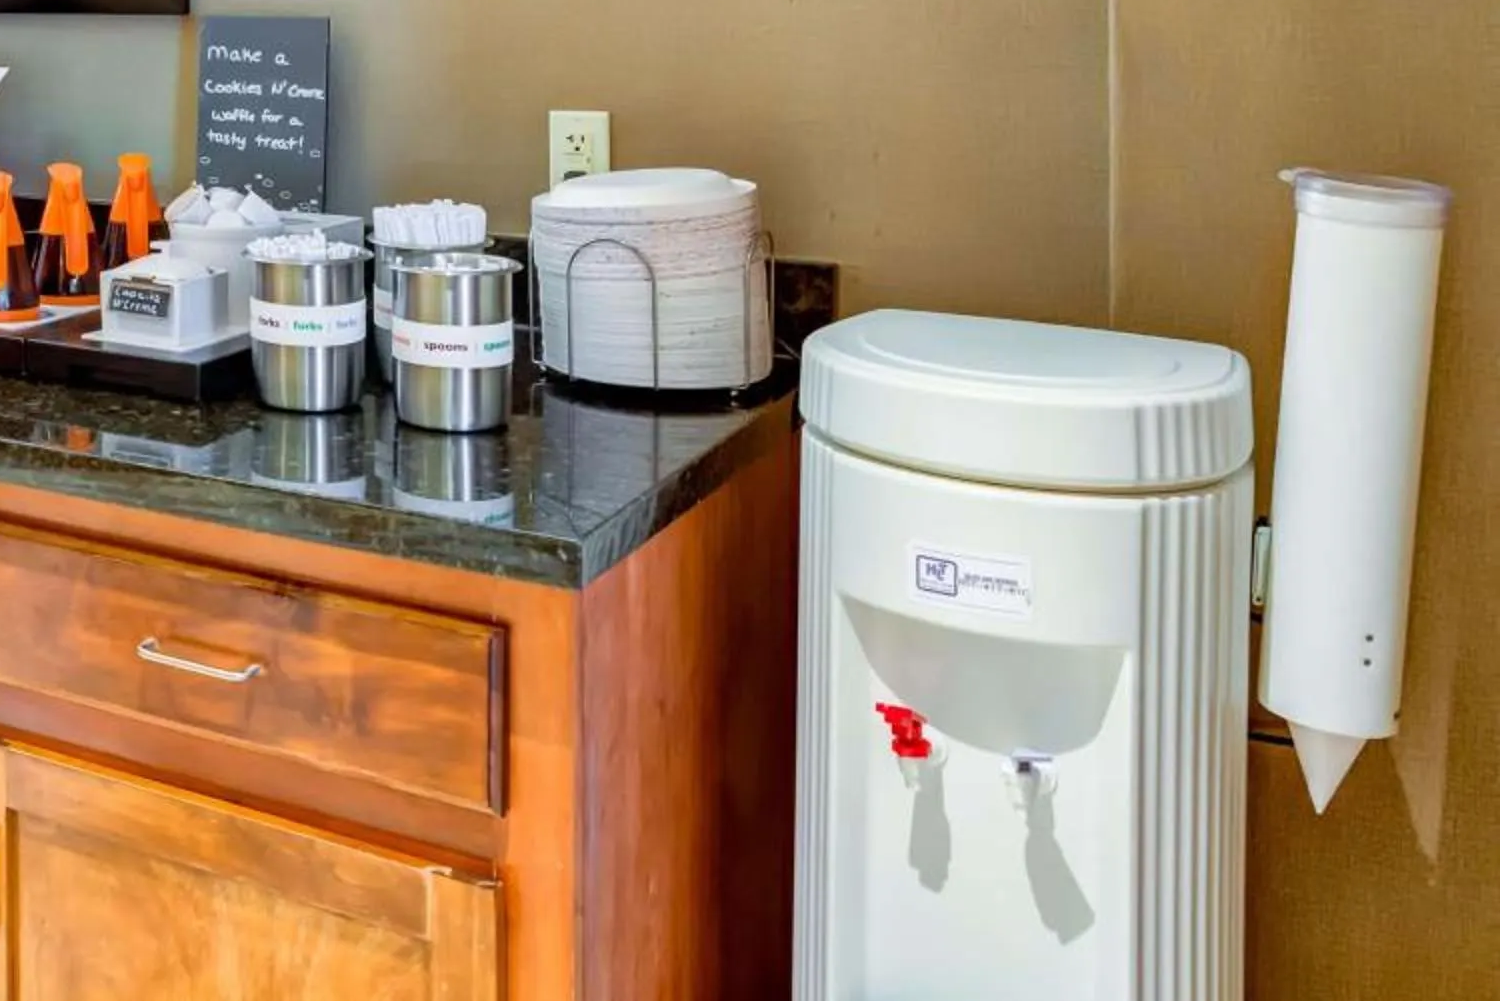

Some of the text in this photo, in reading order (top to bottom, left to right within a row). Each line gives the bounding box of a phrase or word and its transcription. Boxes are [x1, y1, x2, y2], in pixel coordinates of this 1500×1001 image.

[207, 44, 293, 66] Make a
[204, 79, 262, 95] Cookies
[261, 108, 284, 123] for
[288, 116, 305, 126] a
[206, 128, 305, 155] tasty treat!
[422, 341, 468, 352] spoons
